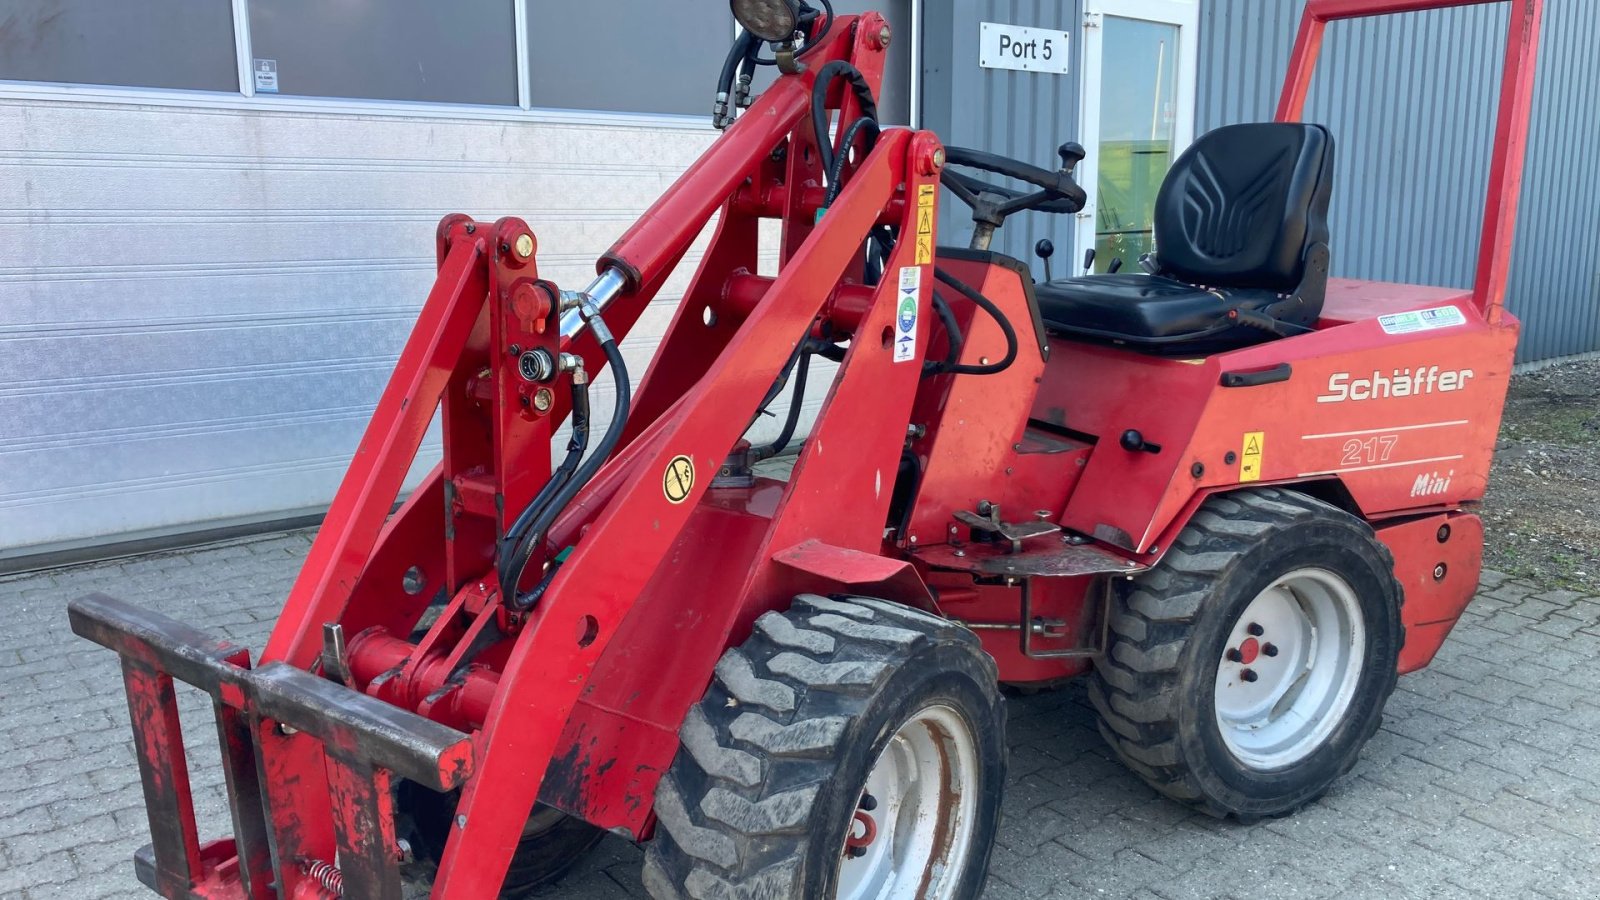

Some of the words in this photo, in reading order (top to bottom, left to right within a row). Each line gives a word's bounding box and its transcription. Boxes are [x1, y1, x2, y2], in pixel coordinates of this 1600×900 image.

[999, 34, 1037, 60] Port
[1042, 38, 1052, 61] 5
[1316, 365, 1474, 403] Schäffer
[1340, 434, 1399, 466] 217
[1410, 469, 1454, 498] Mini
